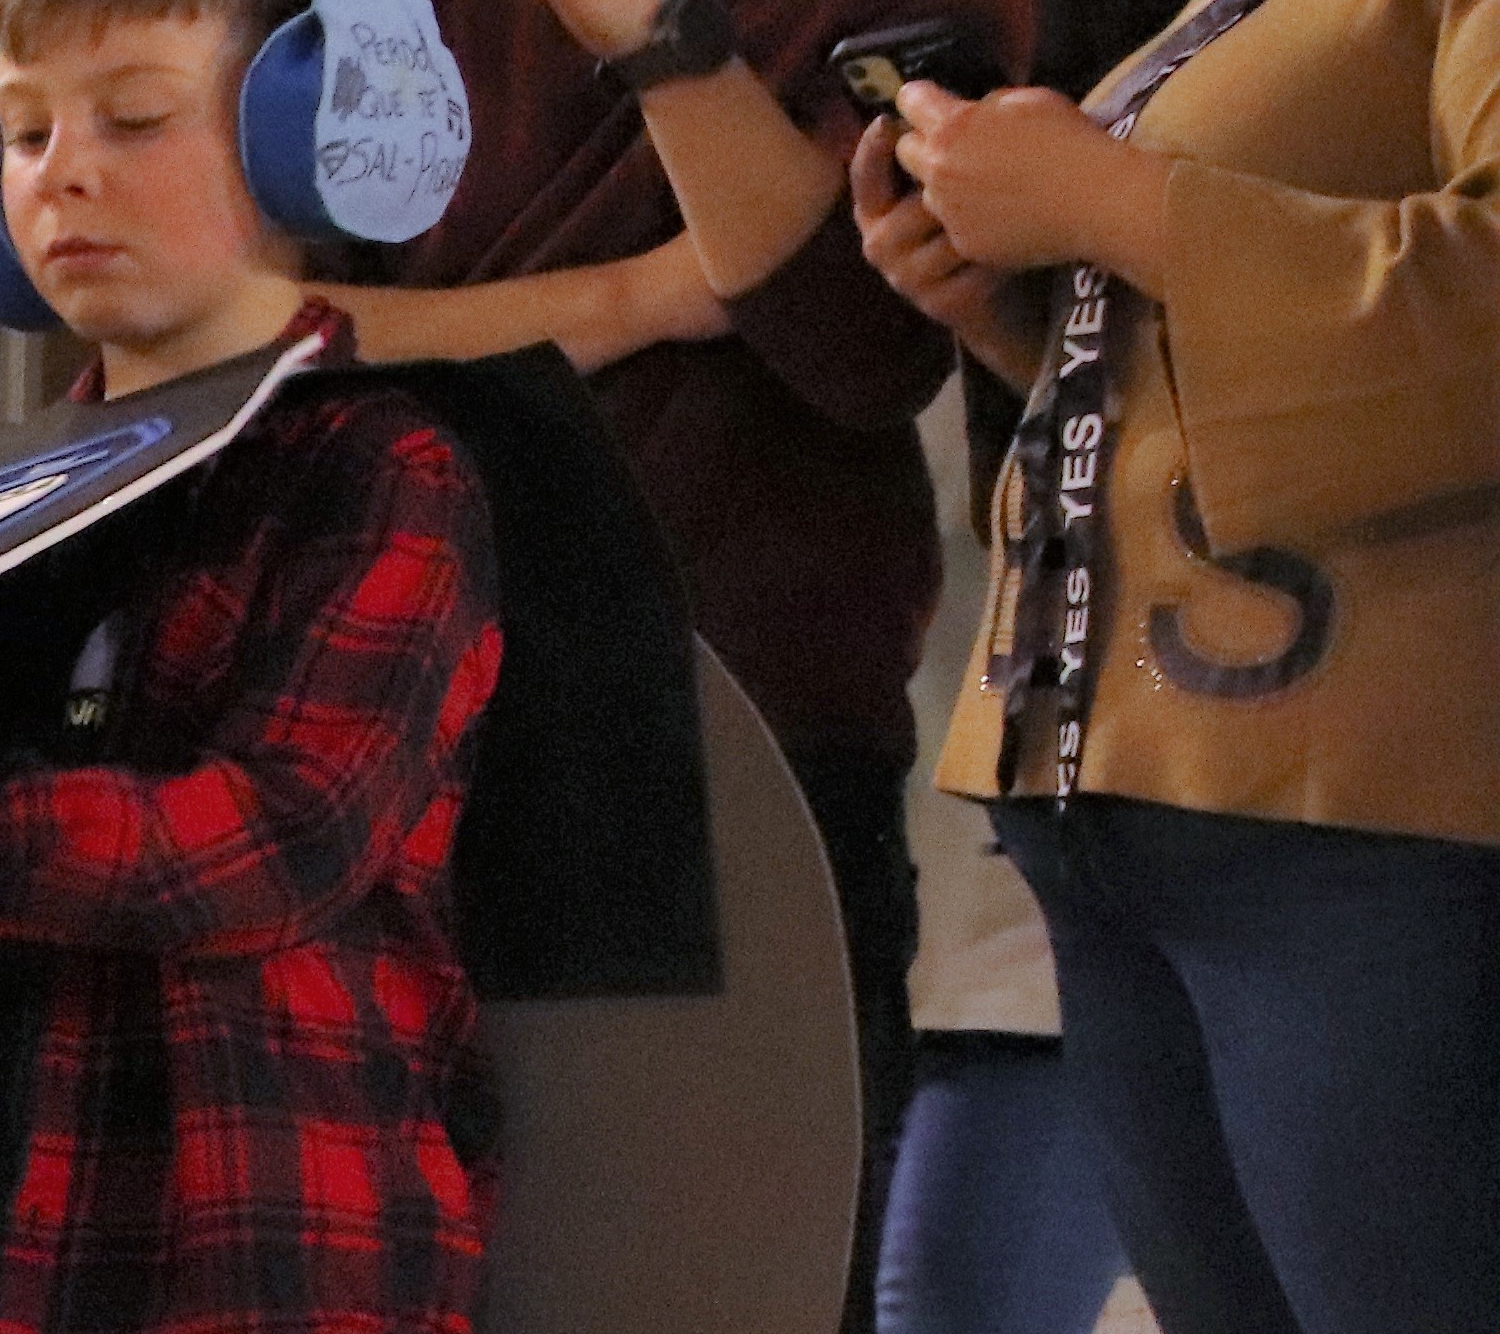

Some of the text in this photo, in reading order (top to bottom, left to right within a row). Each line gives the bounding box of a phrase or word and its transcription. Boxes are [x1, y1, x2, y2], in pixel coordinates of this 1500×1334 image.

[1058, 266, 1107, 379] YES
[1059, 411, 1103, 532] YES
[1057, 565, 1091, 686] YES
[1057, 719, 1081, 813] ES
